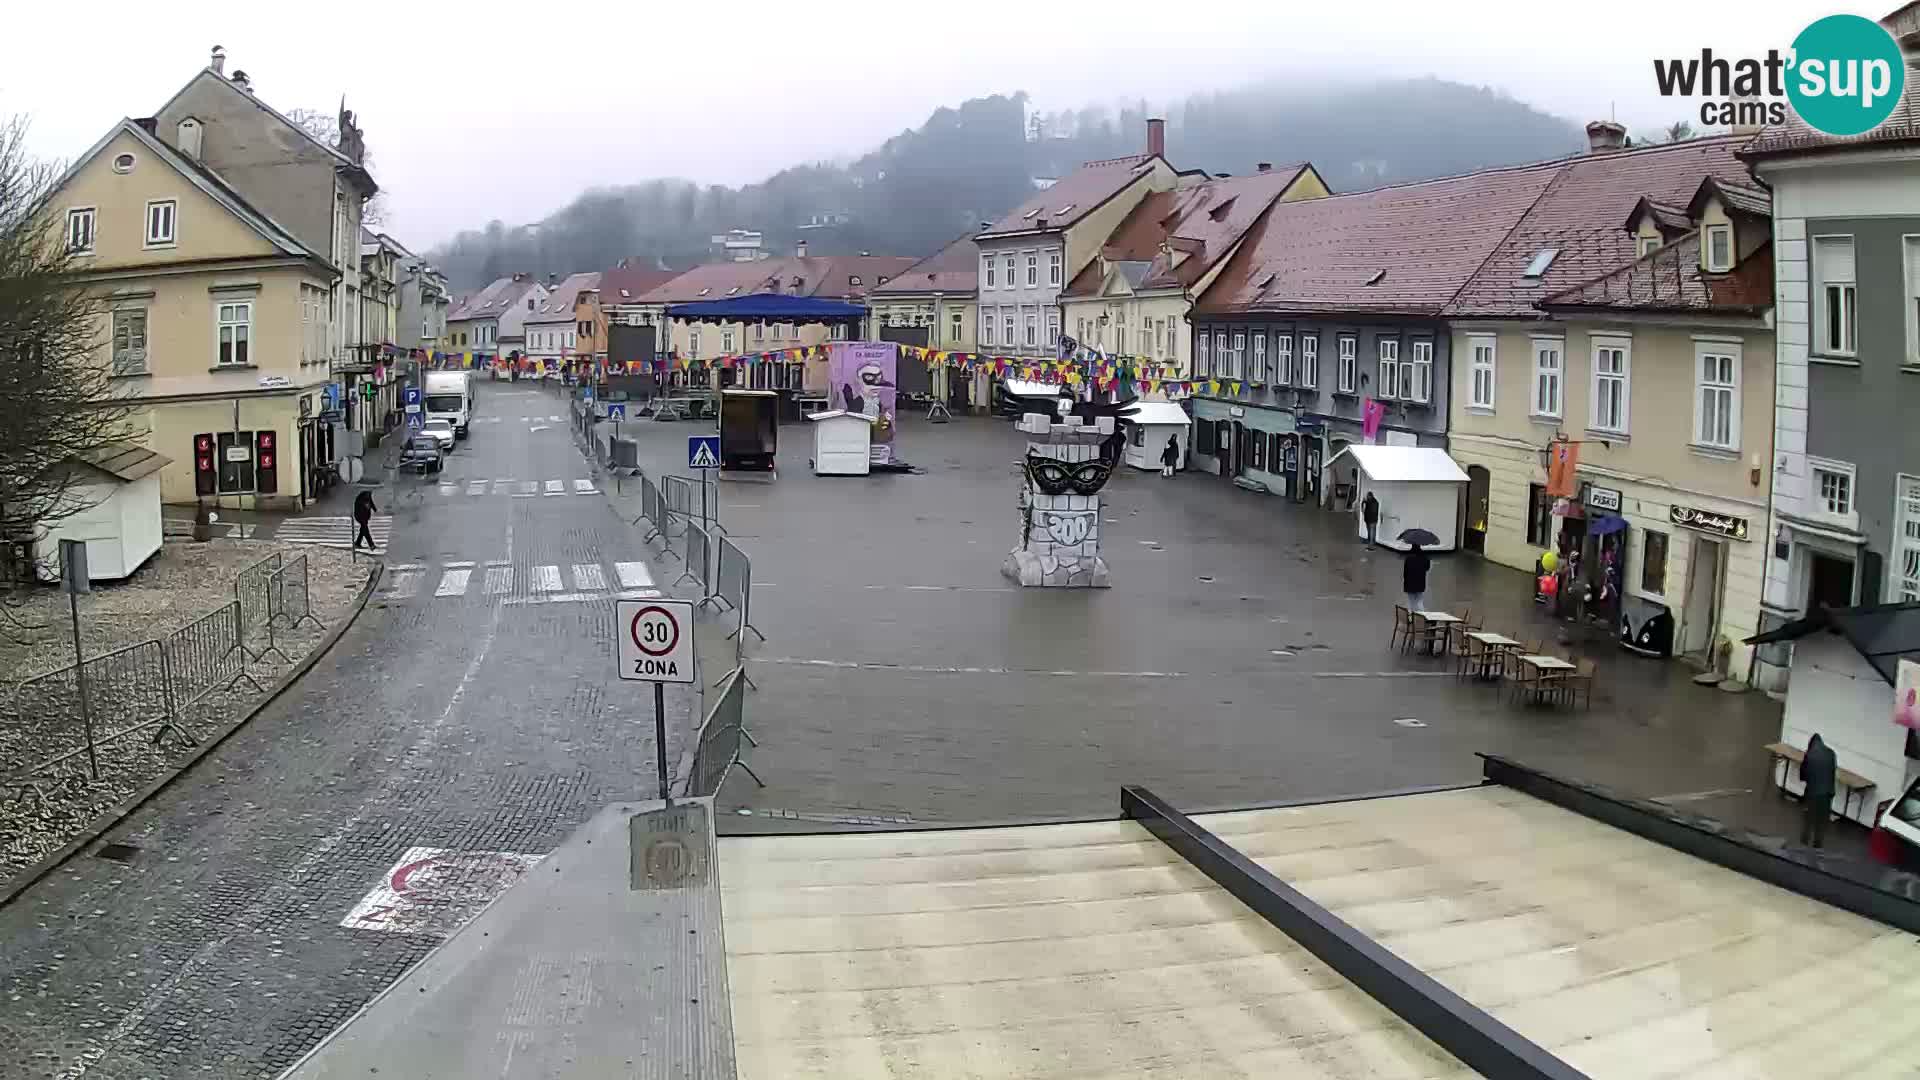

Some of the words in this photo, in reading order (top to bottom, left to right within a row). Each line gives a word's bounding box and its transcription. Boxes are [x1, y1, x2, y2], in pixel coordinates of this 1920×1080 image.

[409, 391, 417, 402] P
[1048, 516, 1087, 544] 200
[644, 621, 668, 643] 30
[634, 659, 678, 676] ZONA
